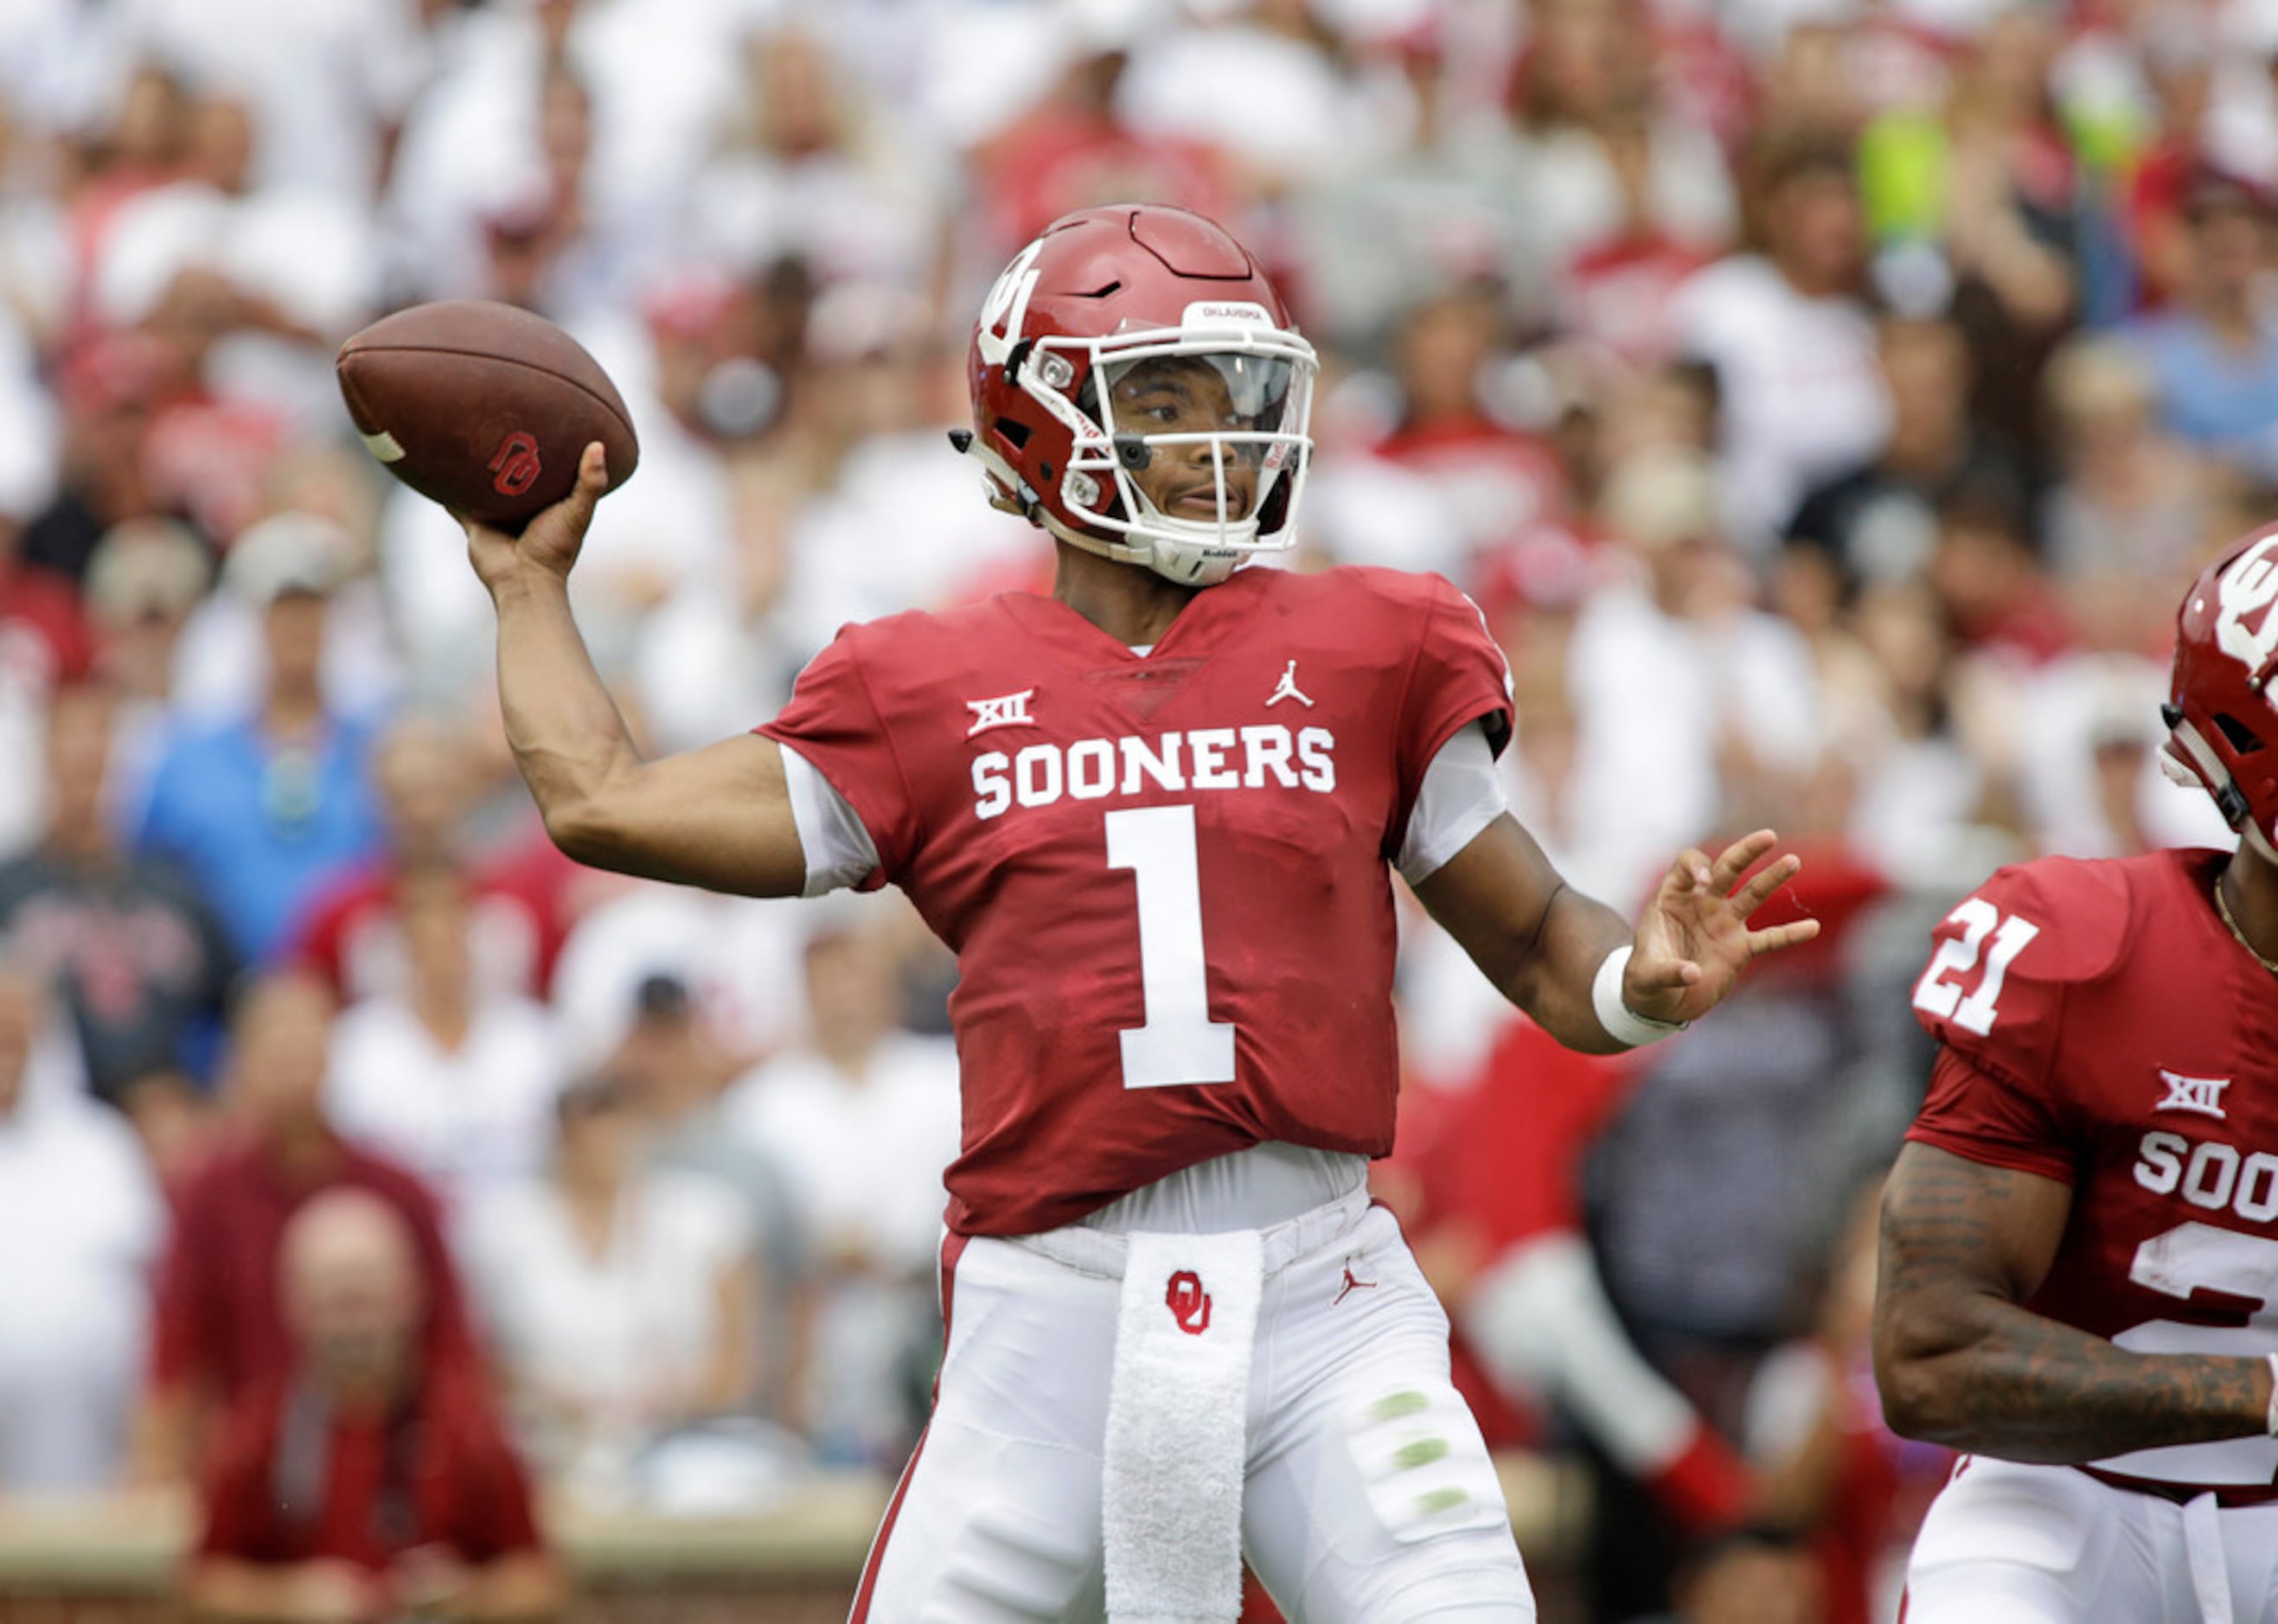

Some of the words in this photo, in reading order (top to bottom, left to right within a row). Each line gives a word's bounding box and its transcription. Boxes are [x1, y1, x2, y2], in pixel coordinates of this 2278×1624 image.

[970, 724, 1337, 822] SOONERS
[1104, 803, 1237, 1090] 1
[1912, 897, 2040, 1037] 21
[1166, 1269, 1213, 1336] OU
